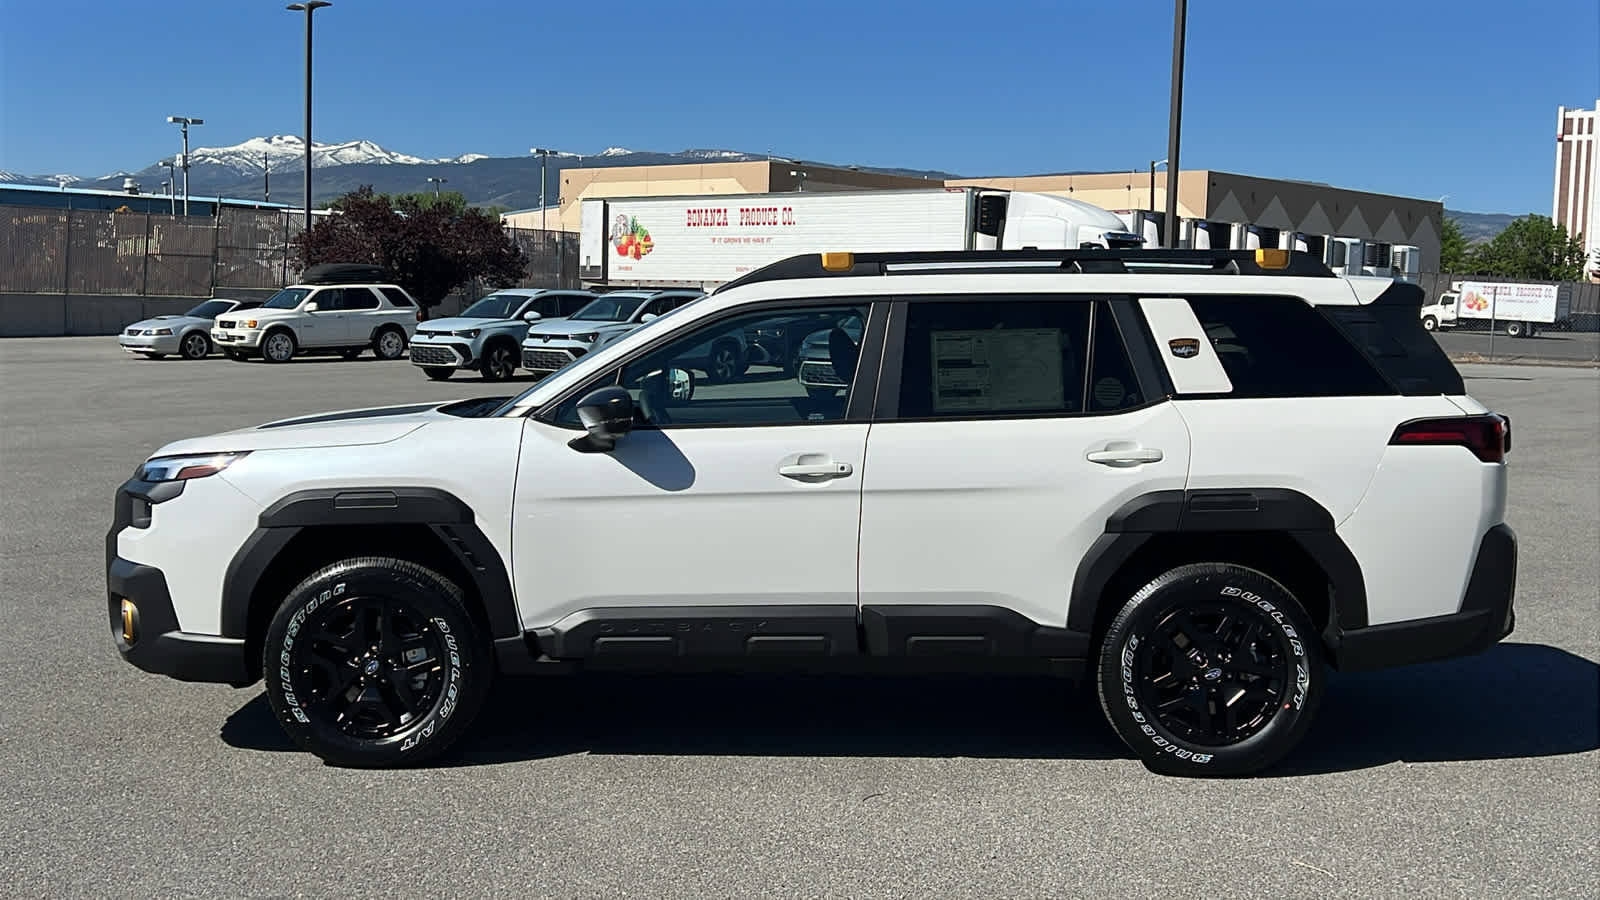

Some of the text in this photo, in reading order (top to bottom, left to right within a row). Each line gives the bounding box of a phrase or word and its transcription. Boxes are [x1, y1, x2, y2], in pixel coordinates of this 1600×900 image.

[687, 206, 796, 227] BONANZA PRODUCE CO.
[280, 583, 347, 724] BRIDGESTONE
[400, 617, 461, 752] DUELER A/T
[1121, 633, 1214, 764] BRIDGESTONE
[1220, 586, 1308, 711] DUELER A/T
